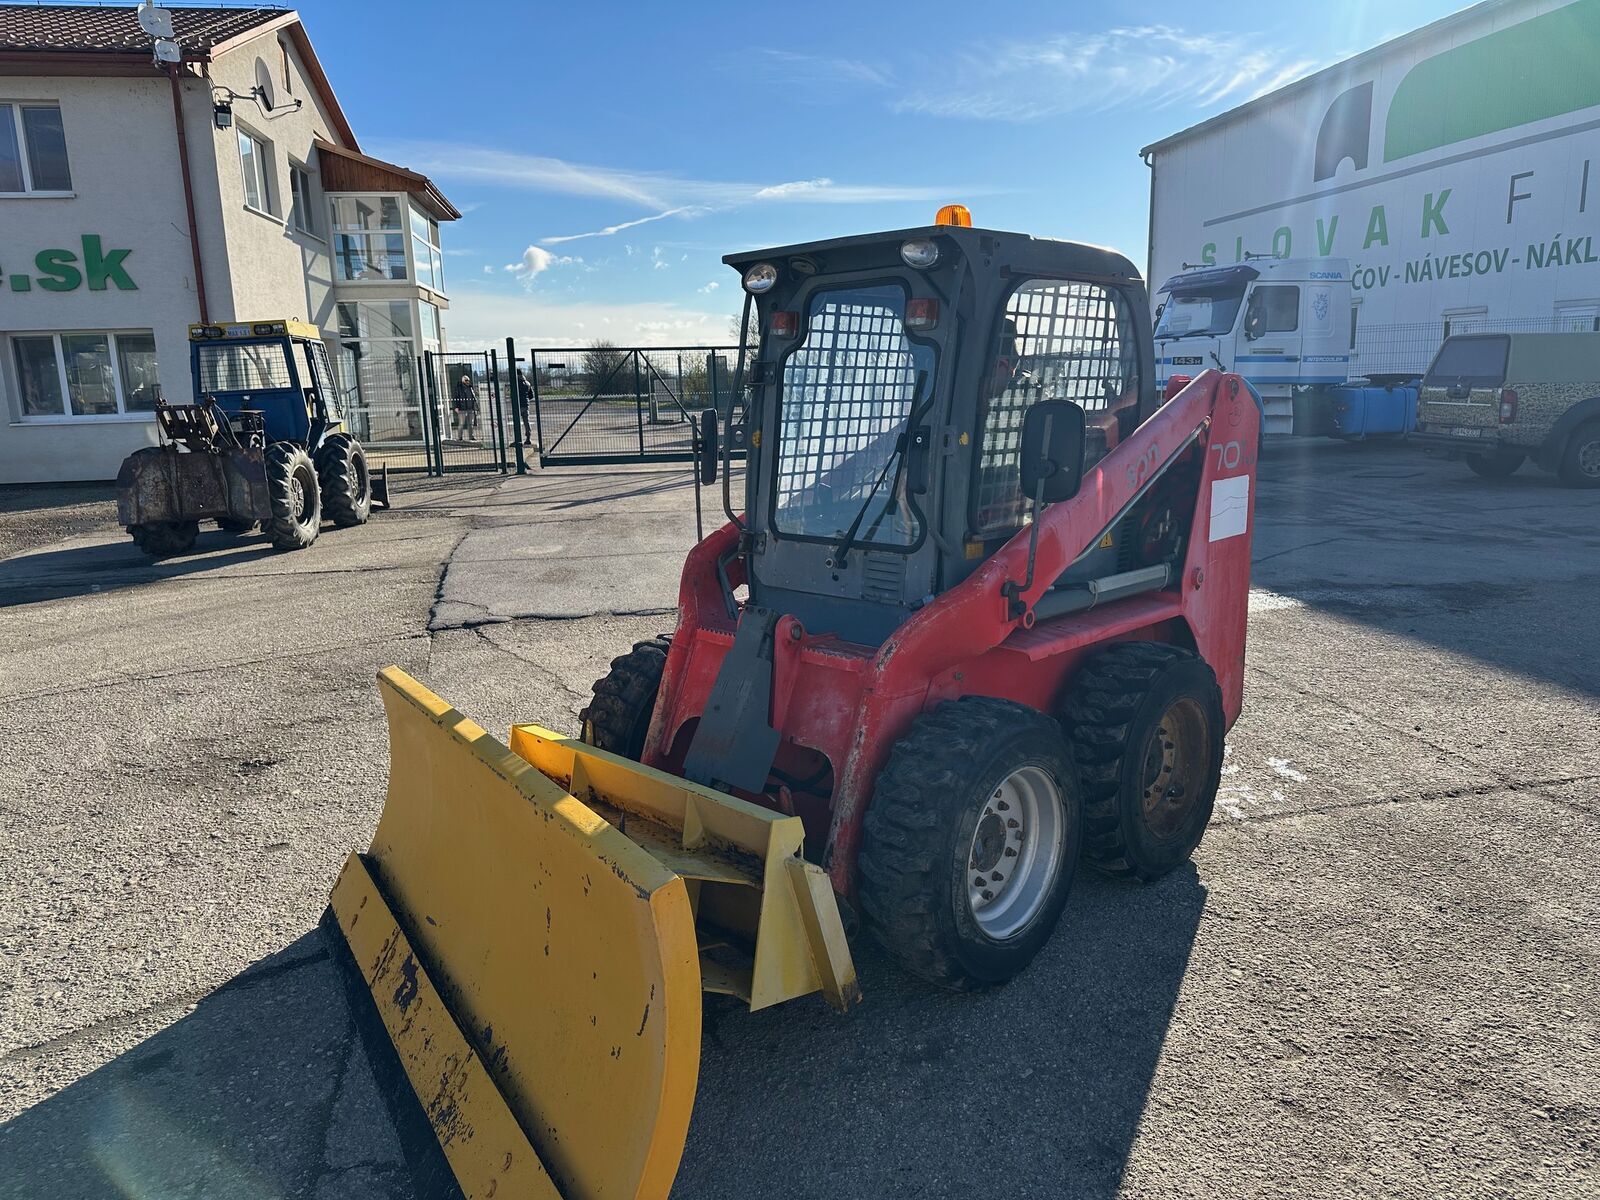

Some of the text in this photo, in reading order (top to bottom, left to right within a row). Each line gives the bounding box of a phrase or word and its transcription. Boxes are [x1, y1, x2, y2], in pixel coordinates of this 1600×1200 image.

[1202, 188, 1453, 265] SLOVAK
[0, 234, 139, 292] .sk
[1310, 271, 1343, 280] SCANIA
[1404, 247, 1510, 284] NÁVESOV
[1526, 232, 1600, 270] NÁKL
